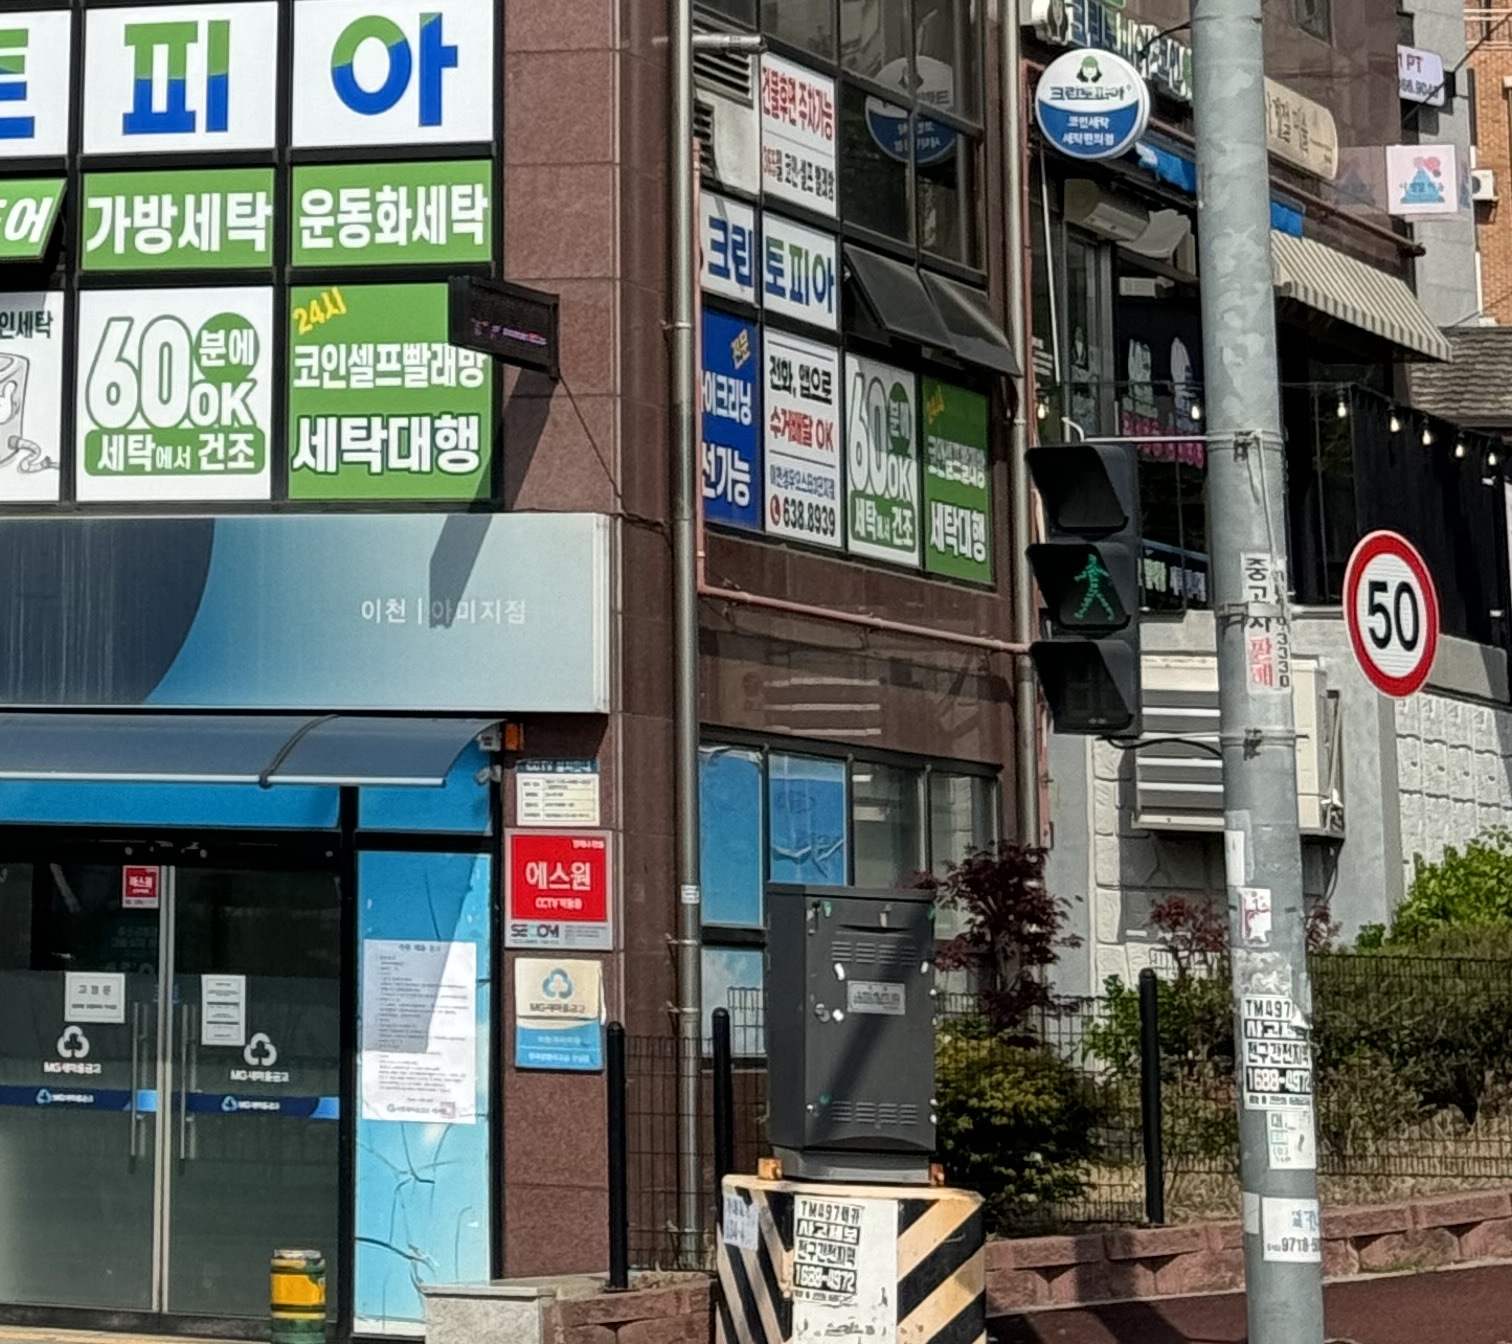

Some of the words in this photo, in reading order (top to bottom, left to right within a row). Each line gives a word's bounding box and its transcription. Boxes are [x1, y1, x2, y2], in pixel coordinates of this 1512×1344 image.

[86, 191, 273, 254] 가방세탁
[299, 182, 489, 250] 운동화세탁
[707, 214, 835, 314] 크린토피아
[292, 286, 347, 336] 24시
[85, 314, 194, 428] 60
[198, 328, 255, 367] 분에
[190, 377, 258, 426] OK
[700, 369, 752, 426] 이크리닝
[799, 364, 833, 405] 앱으로
[97, 432, 192, 473] 세탁에서
[197, 431, 256, 471] 건조
[292, 414, 480, 474] 세탁대행
[816, 421, 834, 453] OK
[848, 371, 888, 496] 60
[887, 454, 913, 501] OK
[701, 440, 751, 507] 선가능
[783, 496, 836, 538] 638.8939
[929, 500, 987, 562] 세탁대행
[361, 597, 406, 624] 이천
[1368, 580, 1420, 652] 50
[525, 861, 591, 891] 에스원
